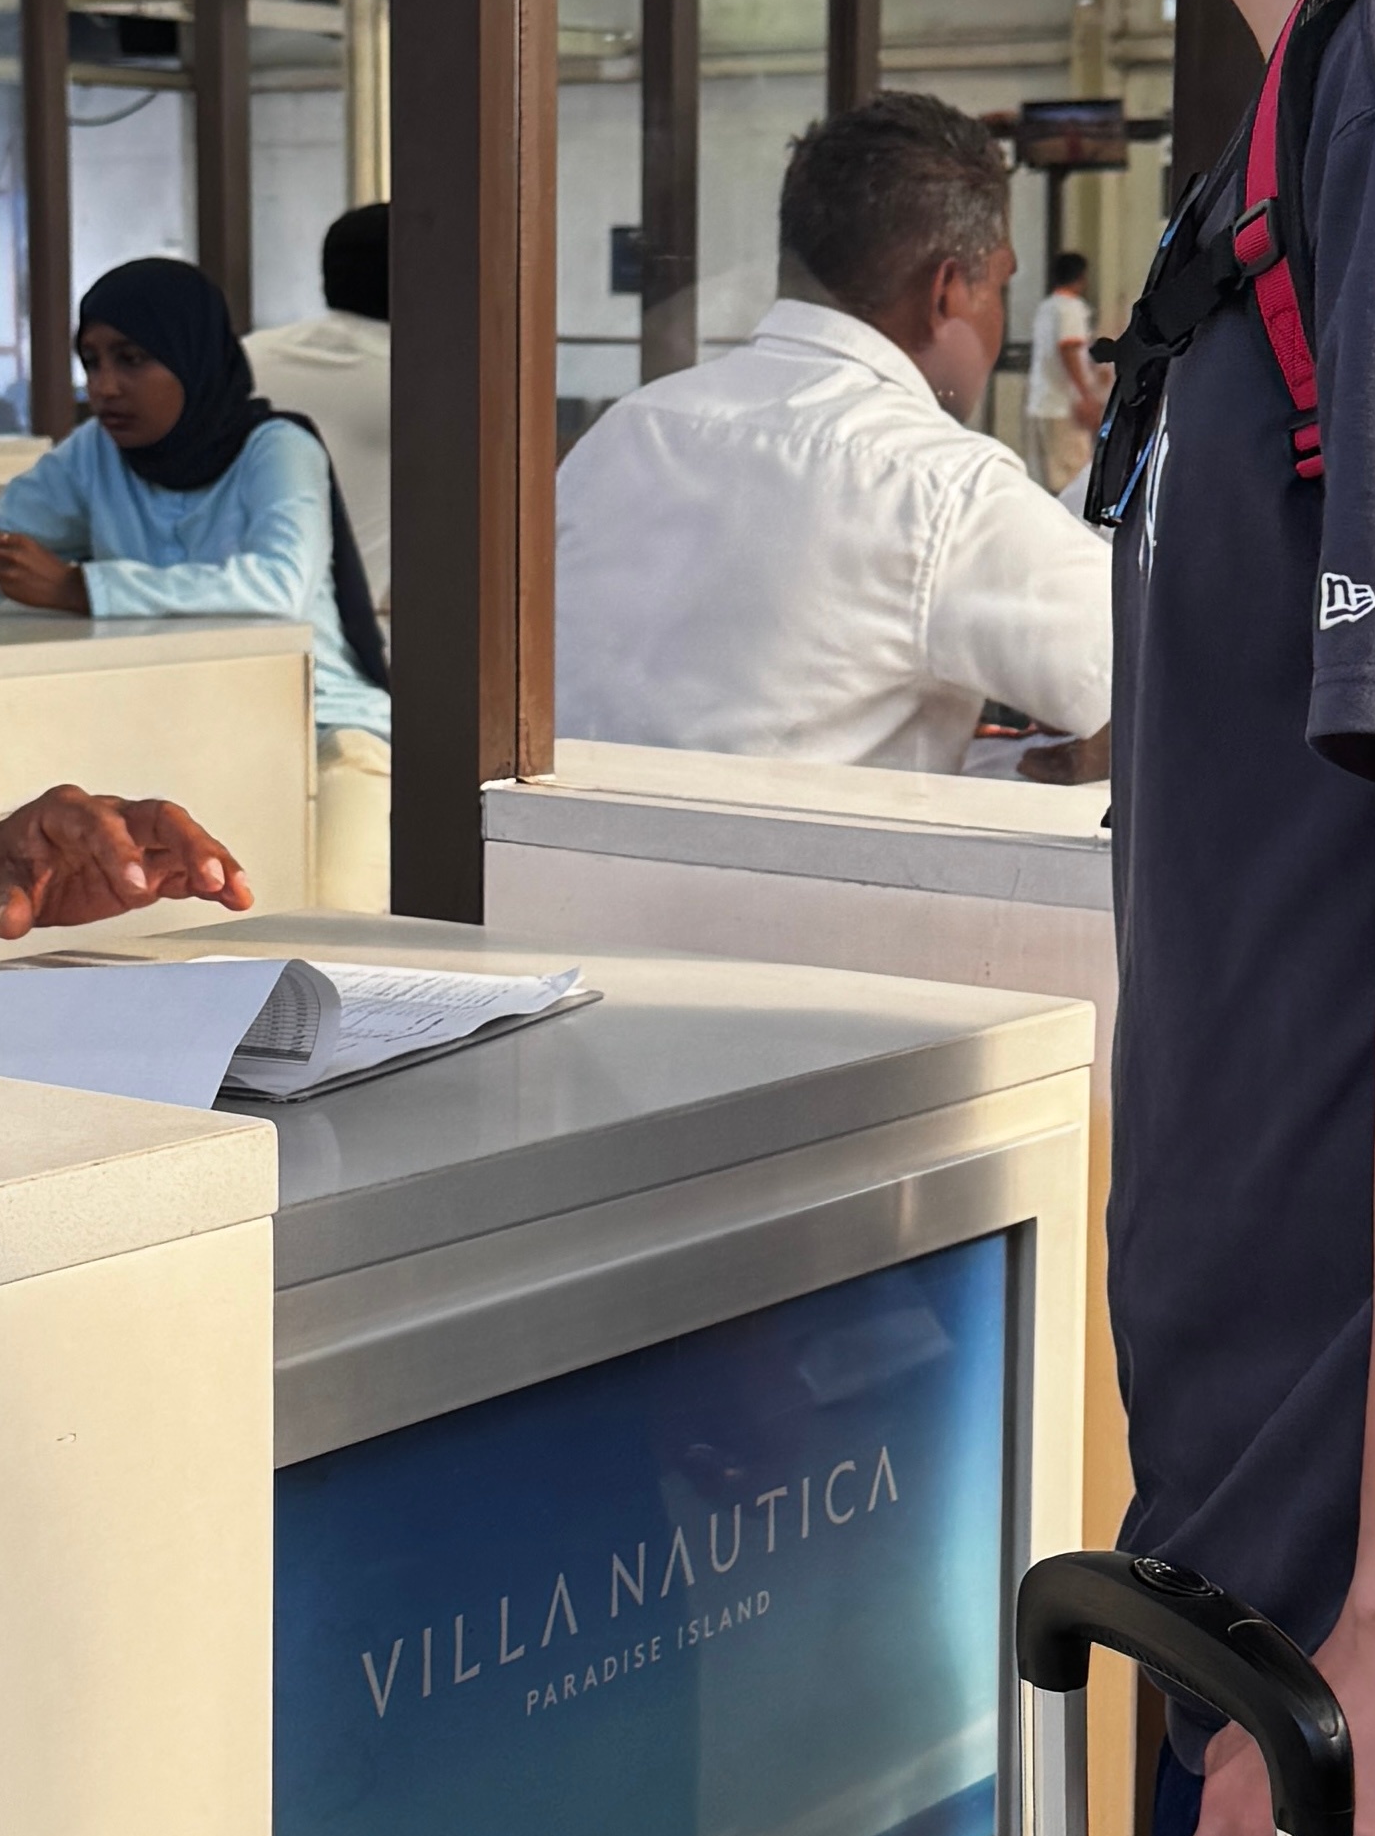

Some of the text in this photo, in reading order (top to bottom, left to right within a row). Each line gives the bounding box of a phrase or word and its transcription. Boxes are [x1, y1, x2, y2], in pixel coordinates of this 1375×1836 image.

[362, 1445, 899, 1719] VILLA NAUTICA
[526, 1590, 771, 1716] PARADISE ISLAND
